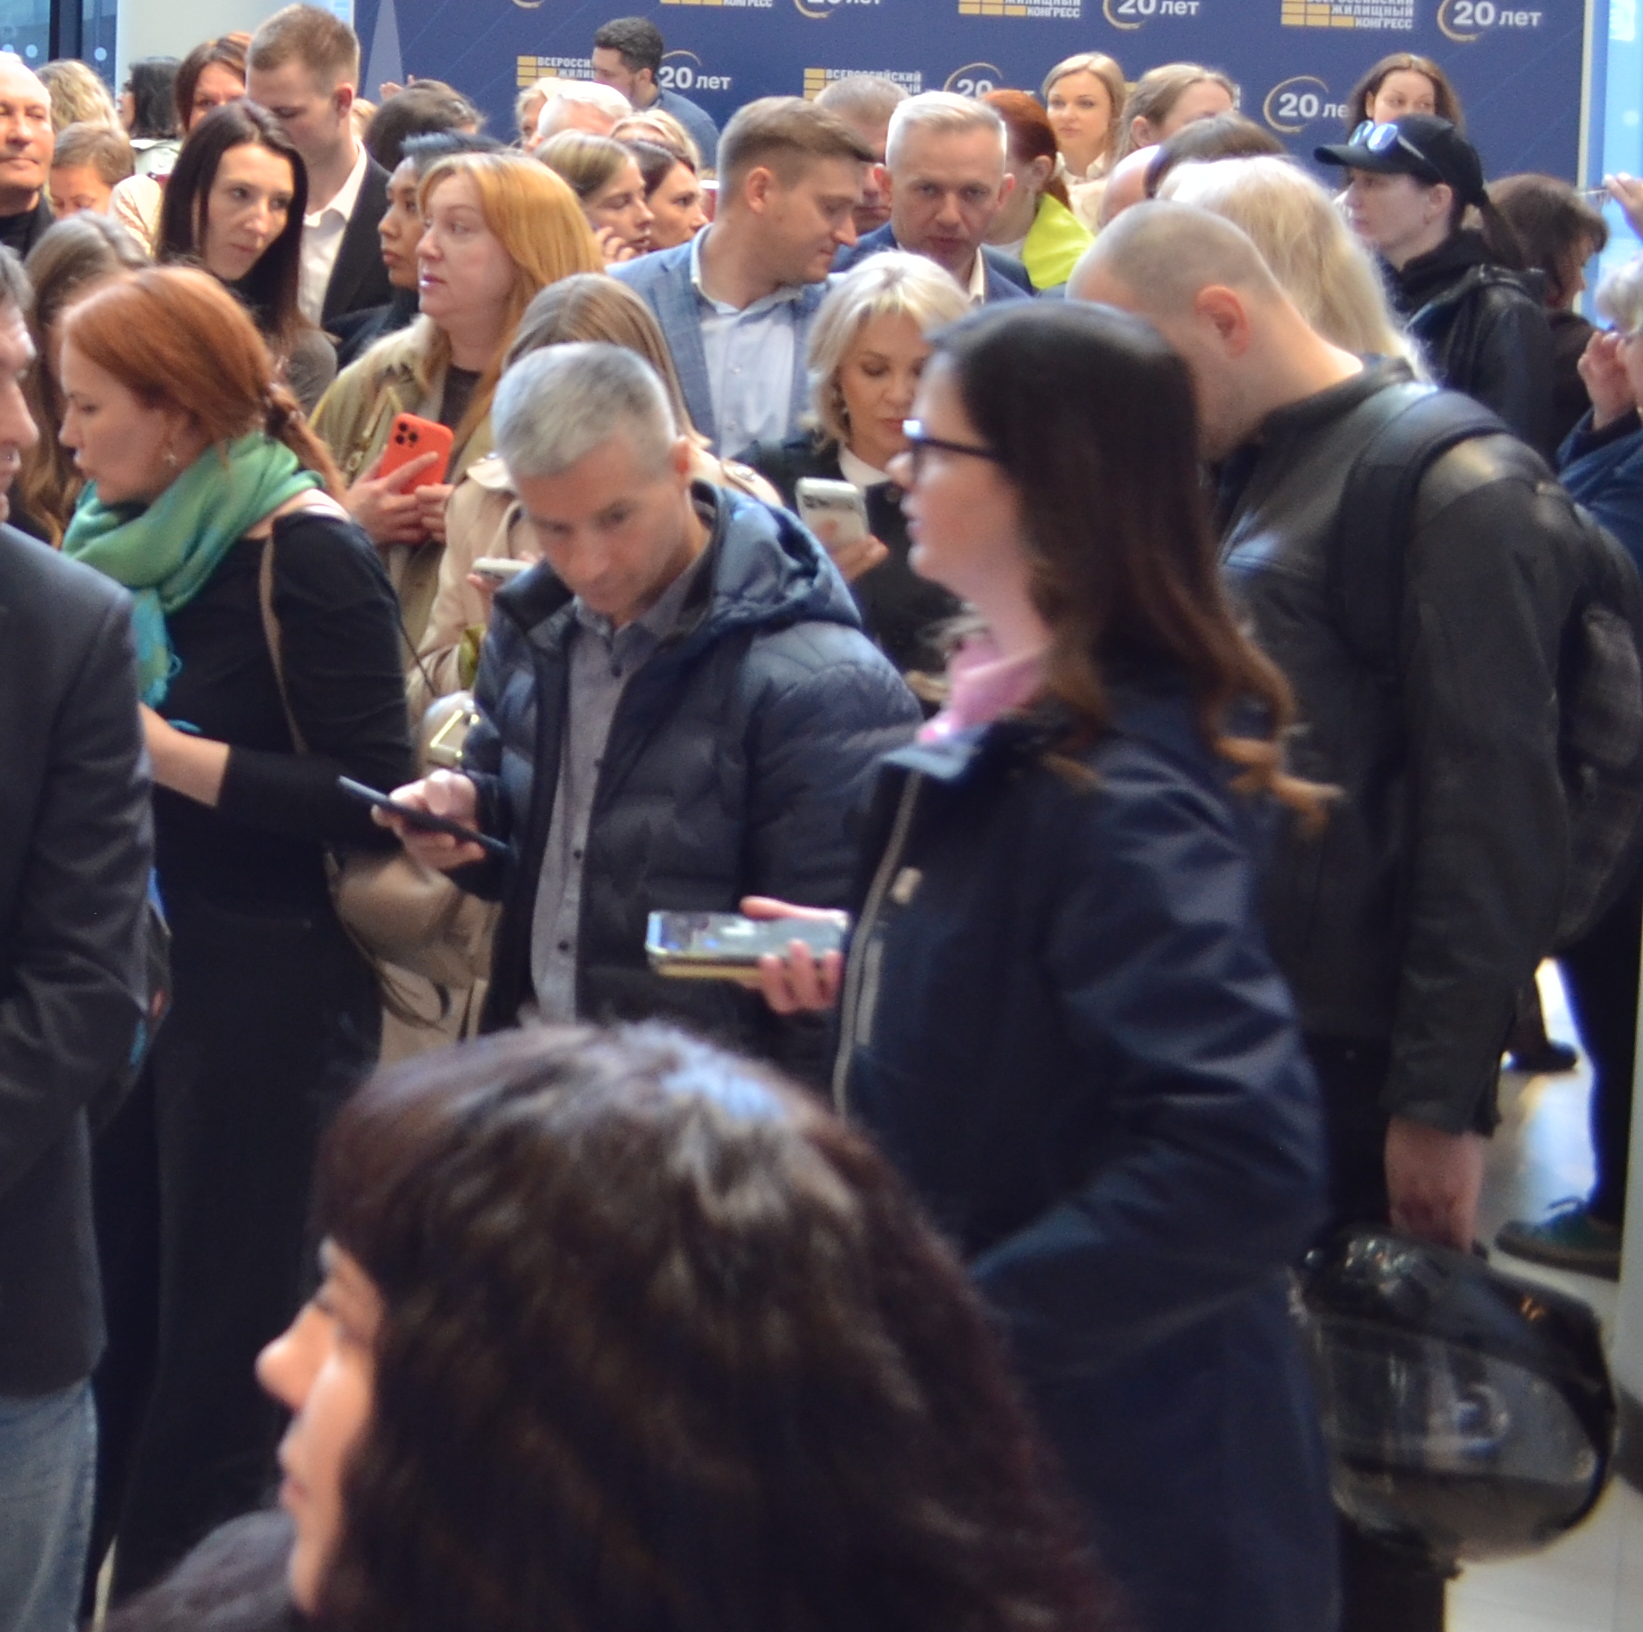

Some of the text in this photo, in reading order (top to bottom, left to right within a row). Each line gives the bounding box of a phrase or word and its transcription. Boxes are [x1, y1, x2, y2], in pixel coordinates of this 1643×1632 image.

[1027, 6, 1081, 18] КОНГРЕСС
[1159, 0, 1200, 16] лет
[1331, 3, 1414, 17] ЖИЛИЩНЫЙ
[1453, 0, 1543, 27] 20 лет
[1355, 17, 1413, 30] КОНГРЕСС
[537, 56, 592, 69] ВСЕРОССИ
[558, 68, 595, 79] ЖИЛИ
[658, 66, 731, 90] 20 лет
[1278, 92, 1349, 118] 20 ле
